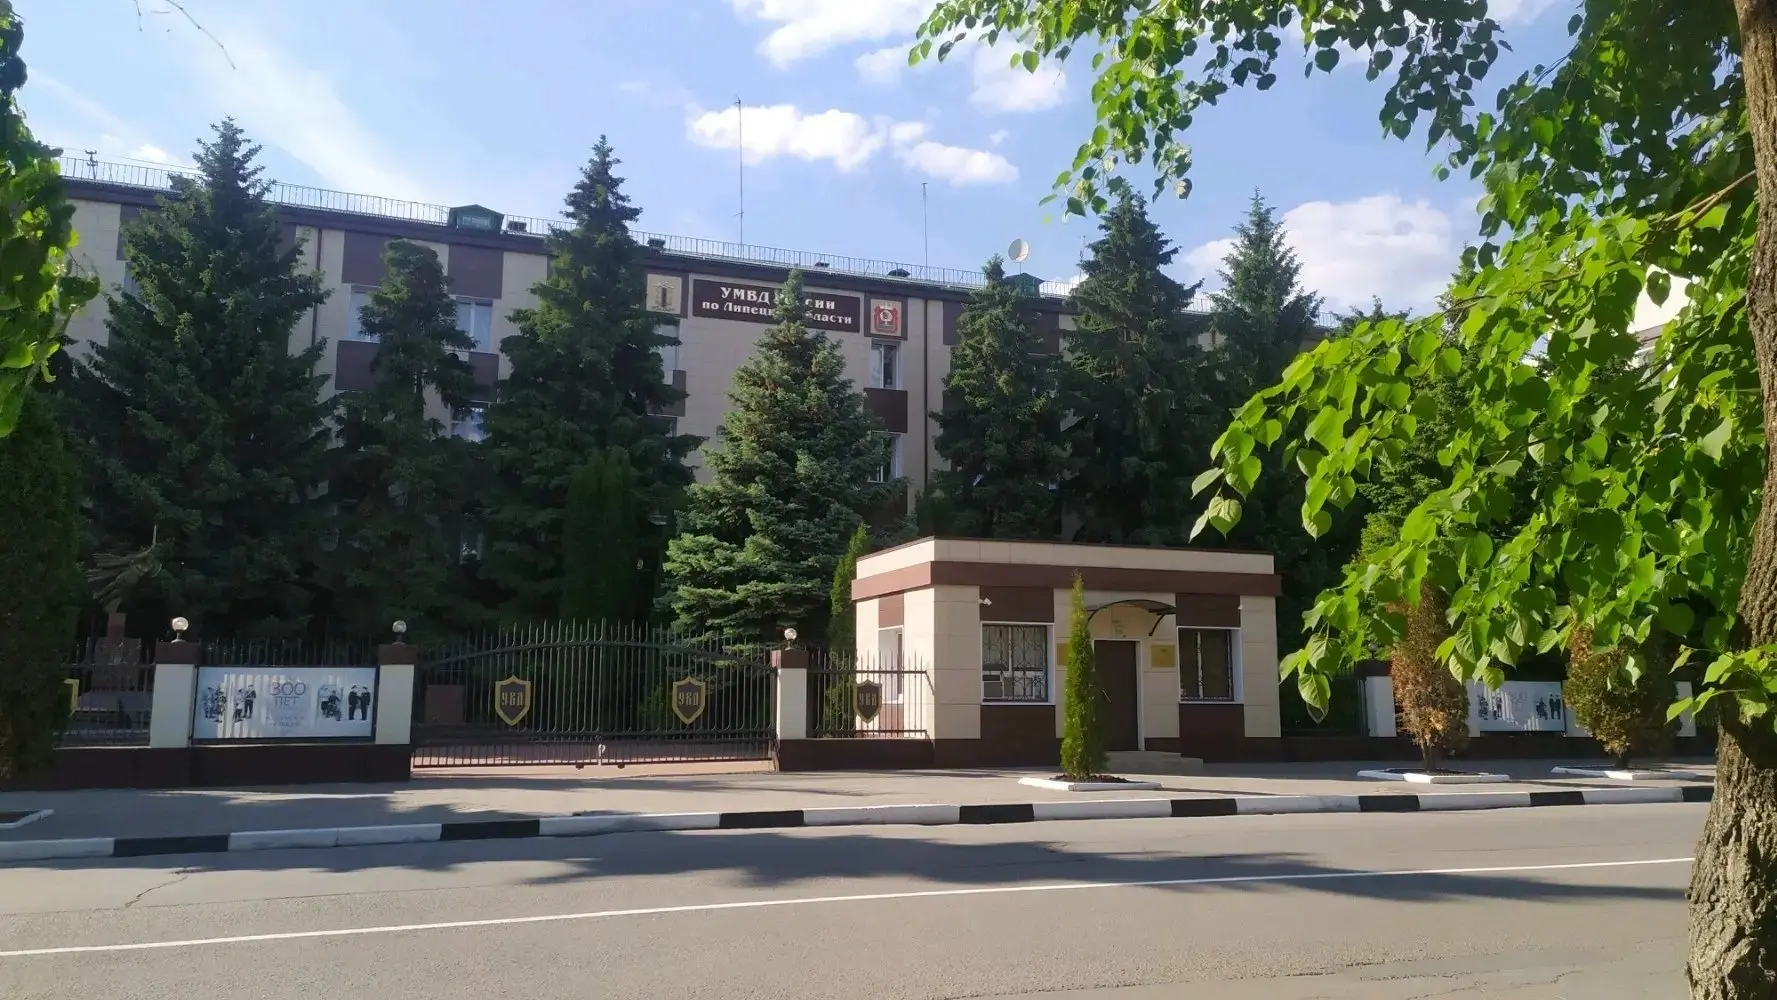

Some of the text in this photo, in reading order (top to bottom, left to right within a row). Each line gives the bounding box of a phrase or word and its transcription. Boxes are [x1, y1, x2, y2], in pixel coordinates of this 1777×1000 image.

[720, 286, 771, 304] УМВД
[702, 301, 720, 310] по
[723, 302, 789, 319] Липец
